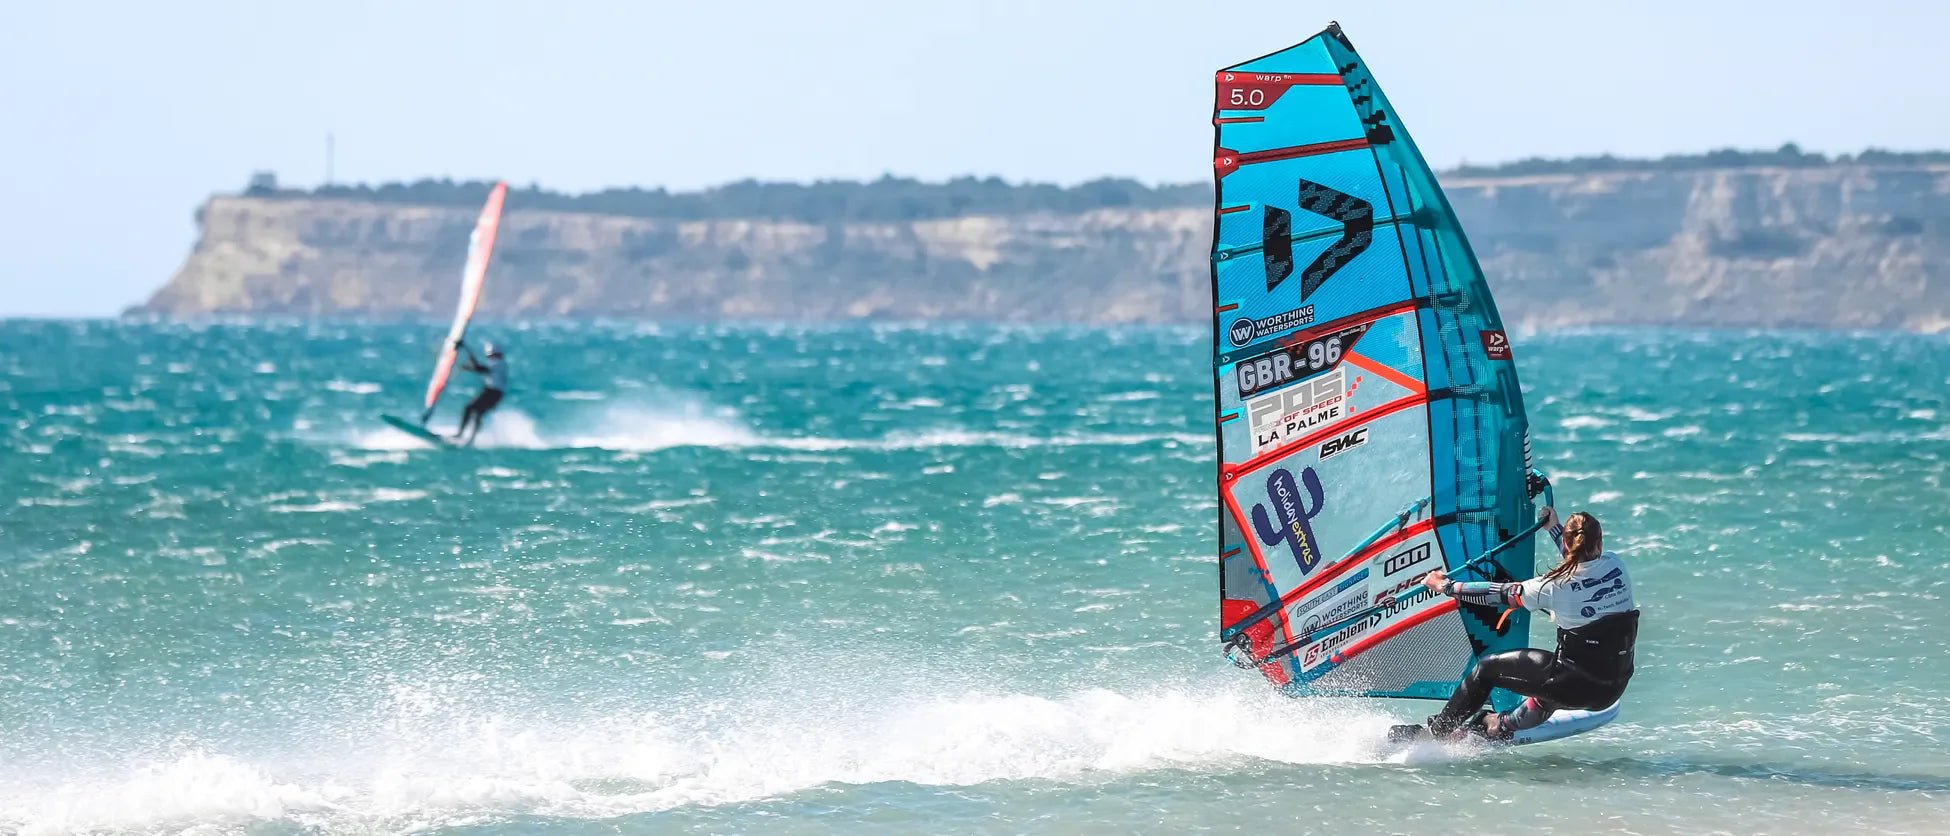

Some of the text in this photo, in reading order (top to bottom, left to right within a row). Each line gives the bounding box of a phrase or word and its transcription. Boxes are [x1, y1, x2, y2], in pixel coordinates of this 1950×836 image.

[1256, 74, 1281, 82] warp
[1230, 88, 1264, 106] 5.0
[1256, 305, 1314, 329] WORTHING
[1256, 315, 1314, 337] WATERSPORTS
[1284, 395, 1342, 422] OF SPEED
[1258, 431, 1280, 447] LA
[1322, 590, 1368, 621] WORTHING
[1321, 619, 1368, 652] Emblem
